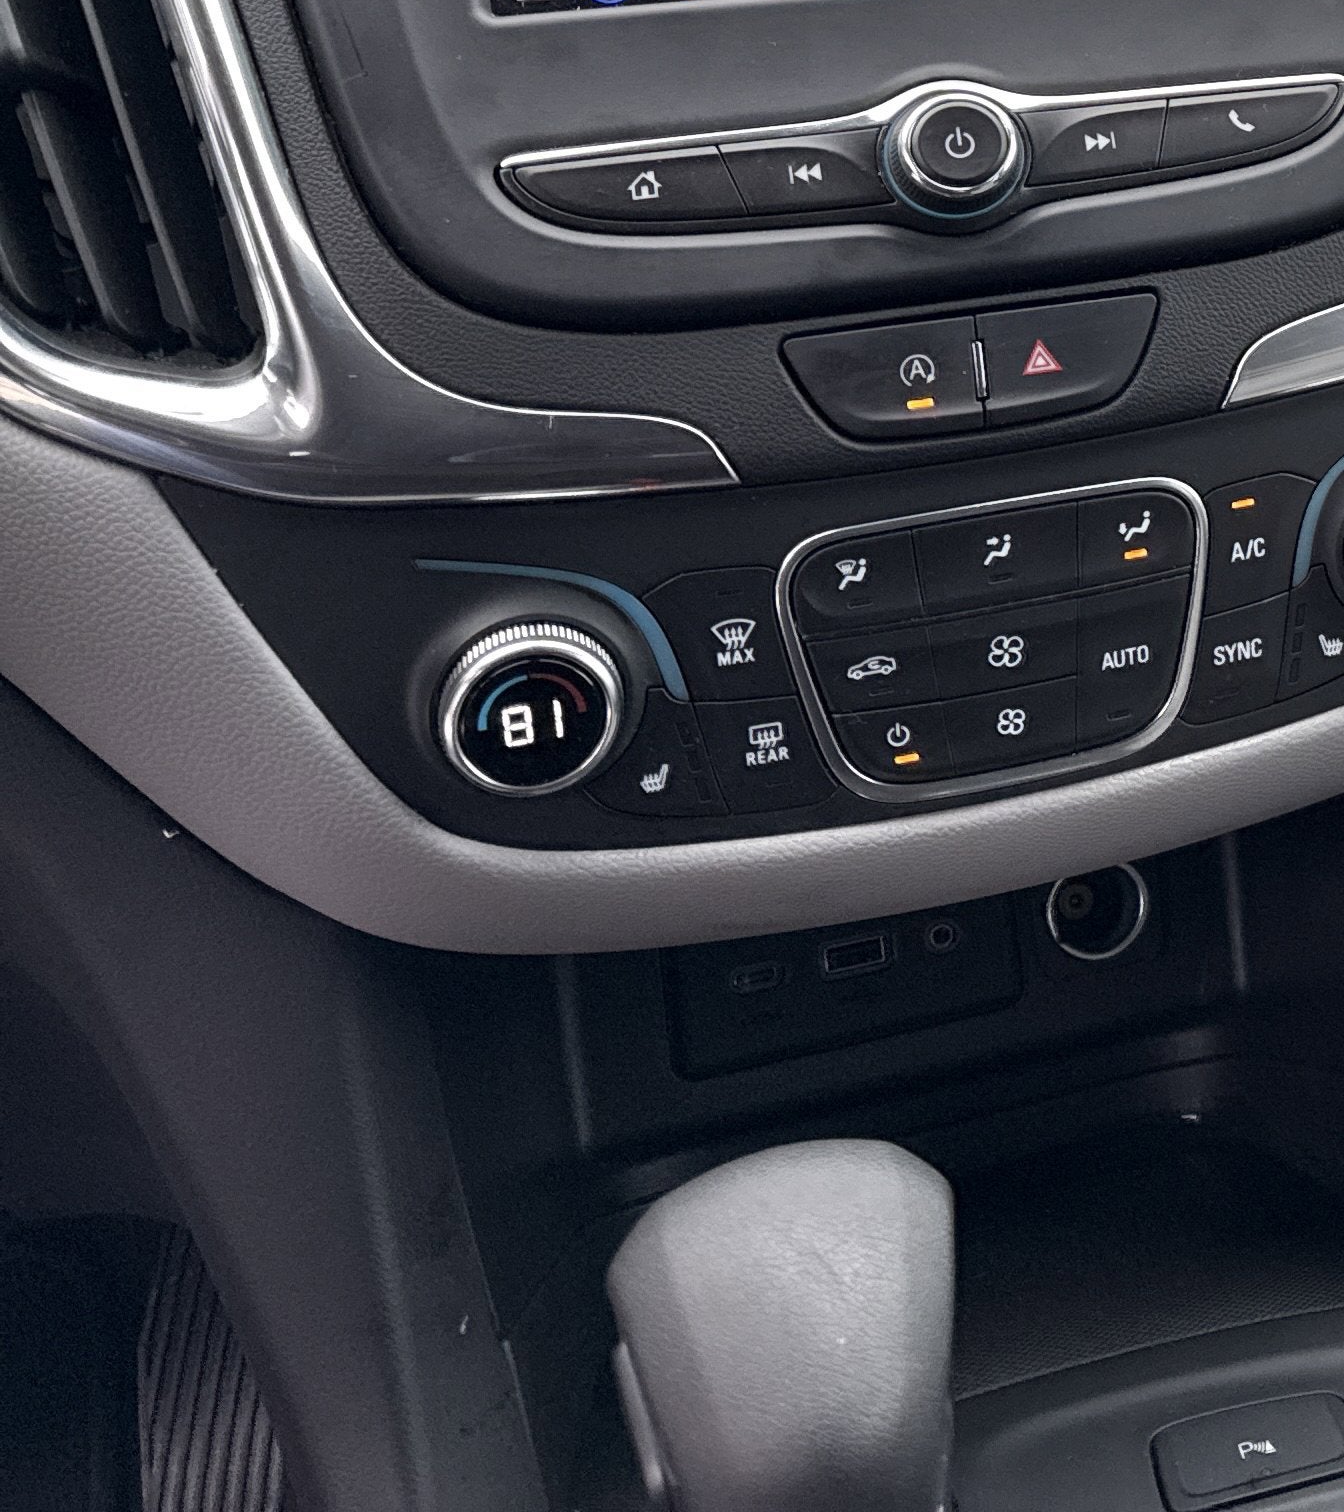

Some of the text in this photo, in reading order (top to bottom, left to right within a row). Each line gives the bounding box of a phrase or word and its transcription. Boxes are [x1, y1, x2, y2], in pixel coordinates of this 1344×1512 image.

[1231, 538, 1266, 563] A/C
[716, 647, 756, 667] MAX
[1101, 644, 1150, 671] AUTO
[1213, 638, 1263, 666] SYNC
[501, 697, 565, 748] 81
[745, 745, 791, 767] REAR
